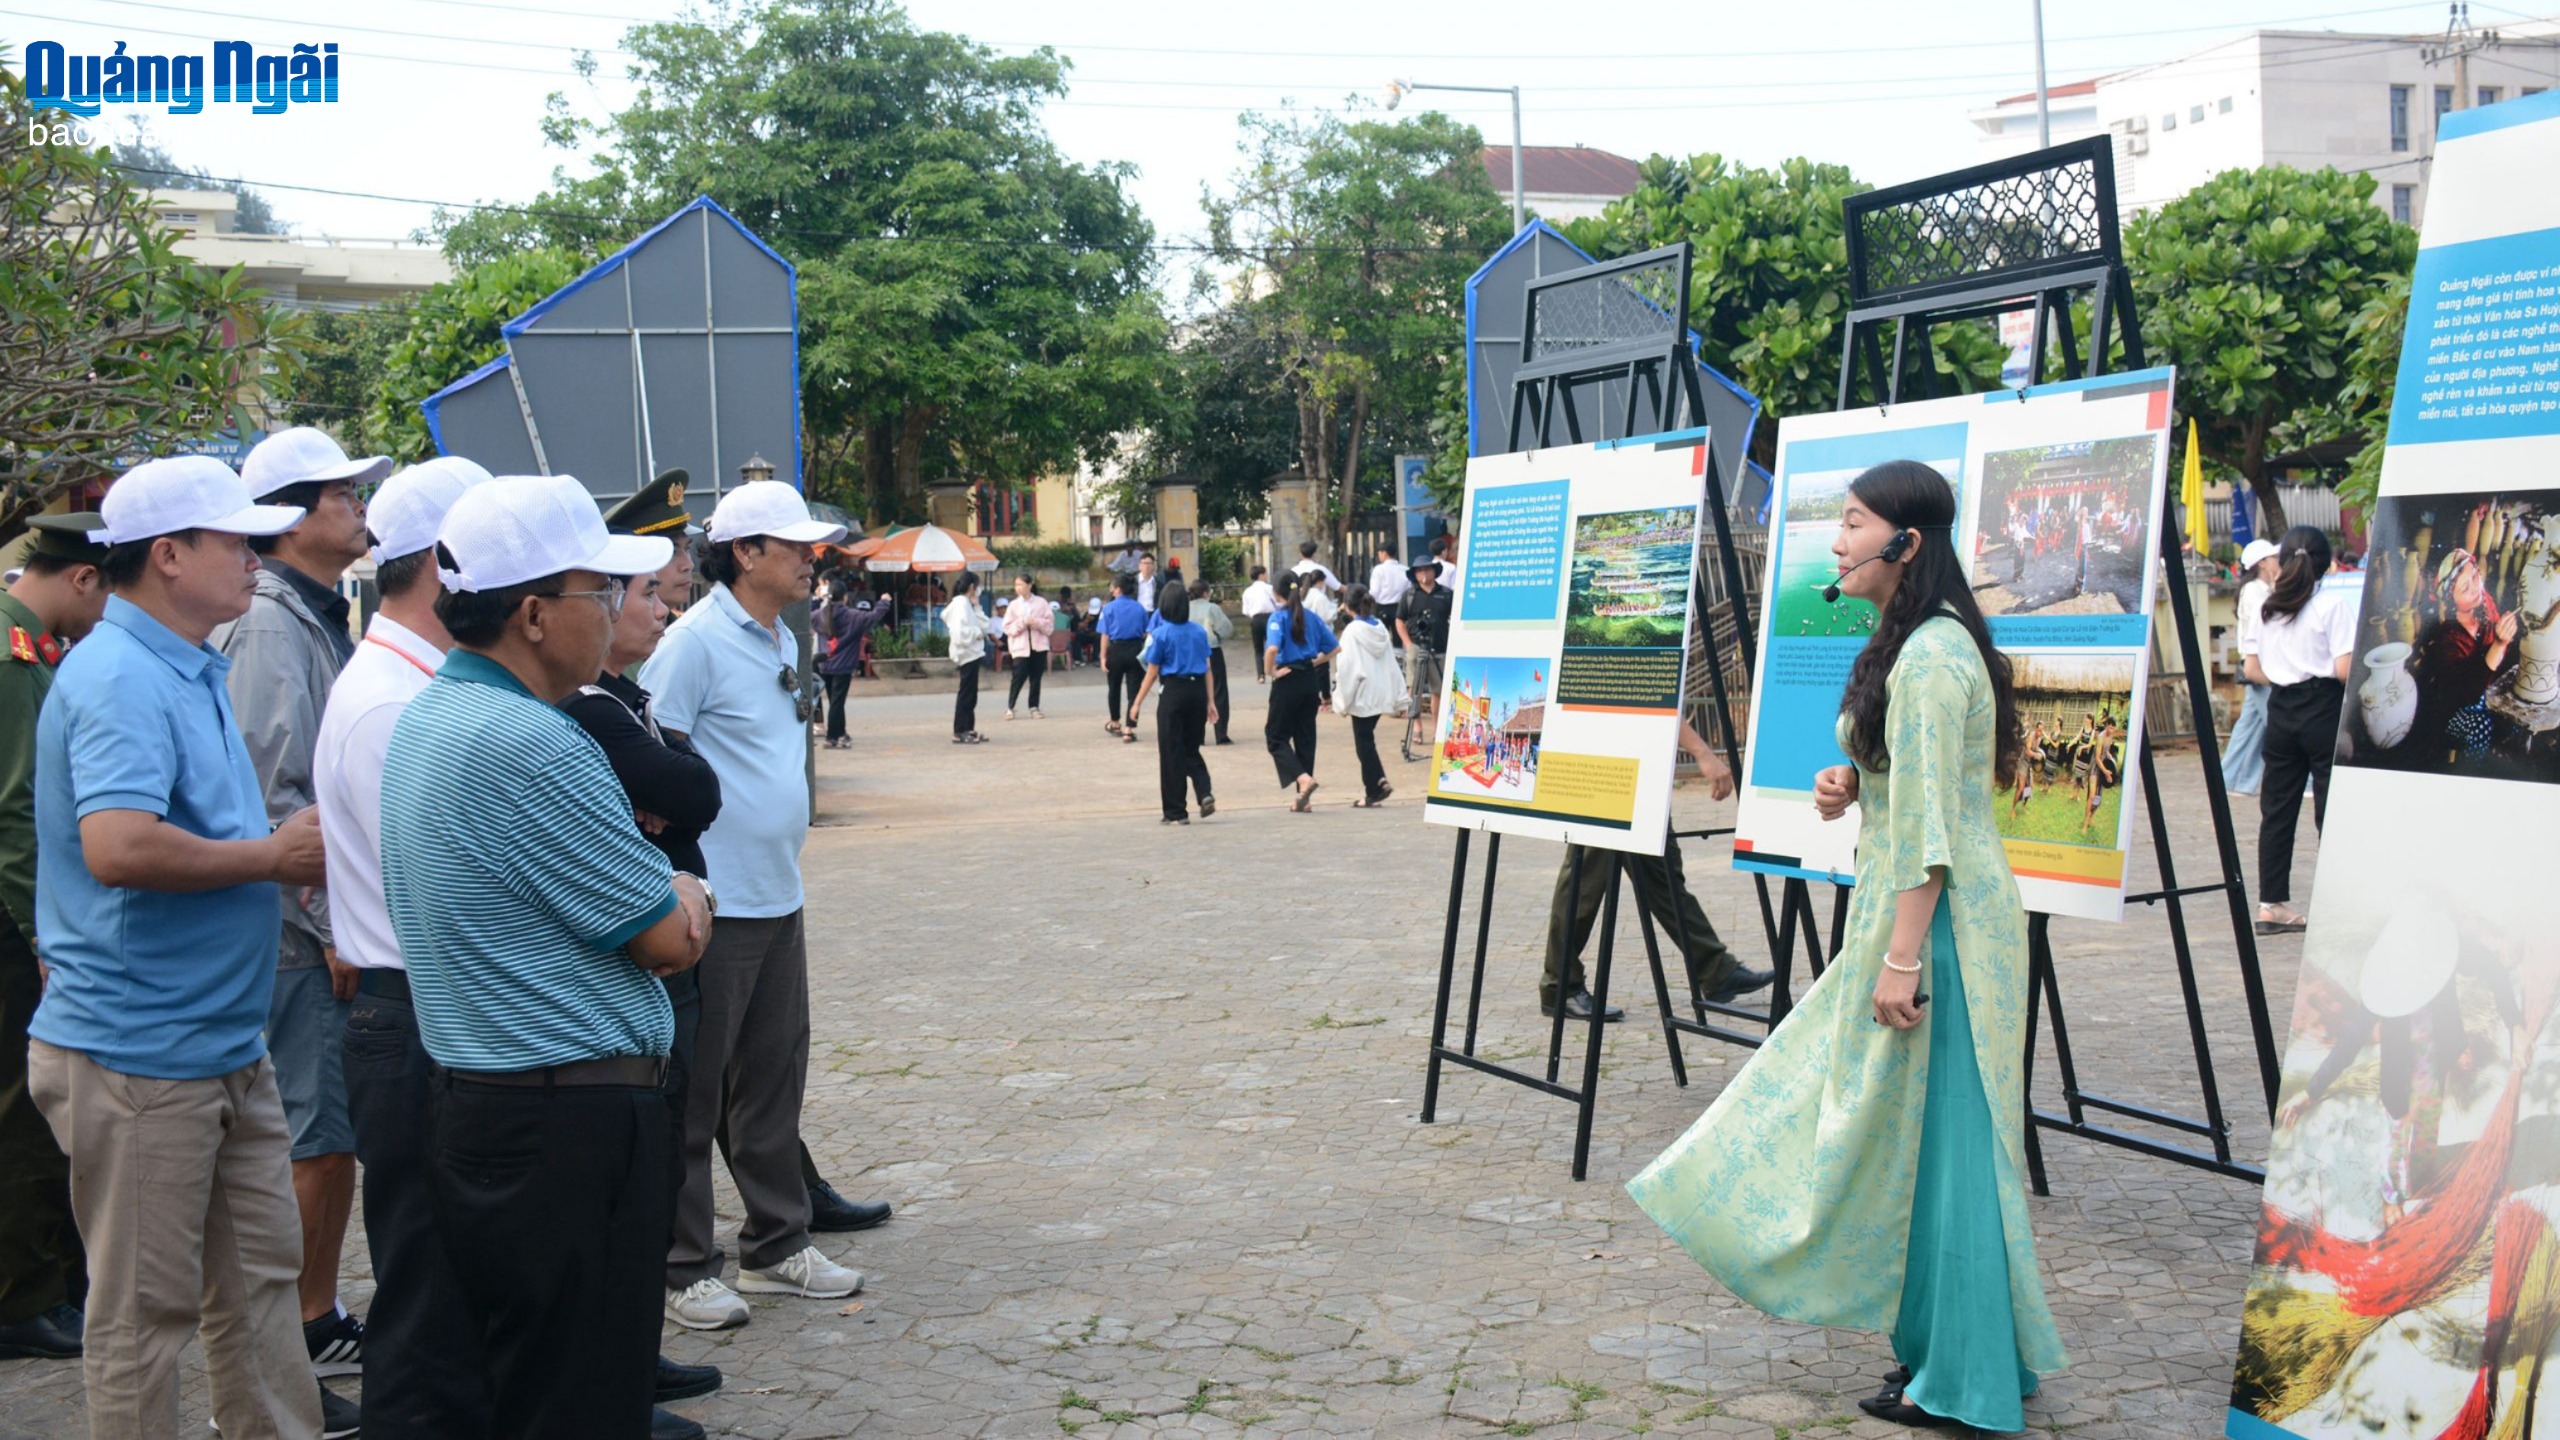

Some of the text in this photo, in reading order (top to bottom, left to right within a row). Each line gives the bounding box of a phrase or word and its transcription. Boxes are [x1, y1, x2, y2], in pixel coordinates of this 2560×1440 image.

[2439, 278, 2469, 292] Quảng
[2471, 274, 2493, 289] Ngãi
[2494, 272, 2511, 284] còn
[2514, 270, 2538, 282] được
[2540, 266, 2550, 277] ví
[2436, 300, 2461, 311] mang
[2464, 294, 2483, 308] đậm
[2486, 292, 2500, 306] giá
[2503, 291, 2513, 303] trị
[2536, 286, 2555, 297] hoa
[2452, 314, 2462, 326] từ
[2464, 311, 2481, 324] thời
[2485, 310, 2501, 322] Văn
[2504, 309, 2521, 319] hóa
[2524, 306, 2536, 318] Sa
[2430, 335, 2450, 349] phát
[2491, 329, 2499, 340] là
[2502, 328, 2518, 339] các
[2522, 325, 2546, 338] nghề
[2427, 352, 2449, 365] miền
[2452, 349, 2469, 363] Bắc
[2498, 347, 2515, 358] vào
[2518, 344, 2539, 356] Nam
[2424, 358, 2558, 384] của người địa phương. Nghề
[2422, 389, 2444, 404] nghề
[2446, 388, 2461, 399] rèn
[2464, 387, 2475, 398] và
[2505, 383, 2516, 394] xà
[2534, 379, 2544, 391] từ
[2418, 408, 2440, 420] miền
[2462, 404, 2473, 416] tất
[2476, 402, 2487, 415] cả
[2489, 403, 2506, 414] hòa
[2508, 399, 2538, 415] quyện
[2541, 399, 2556, 412] tạo
